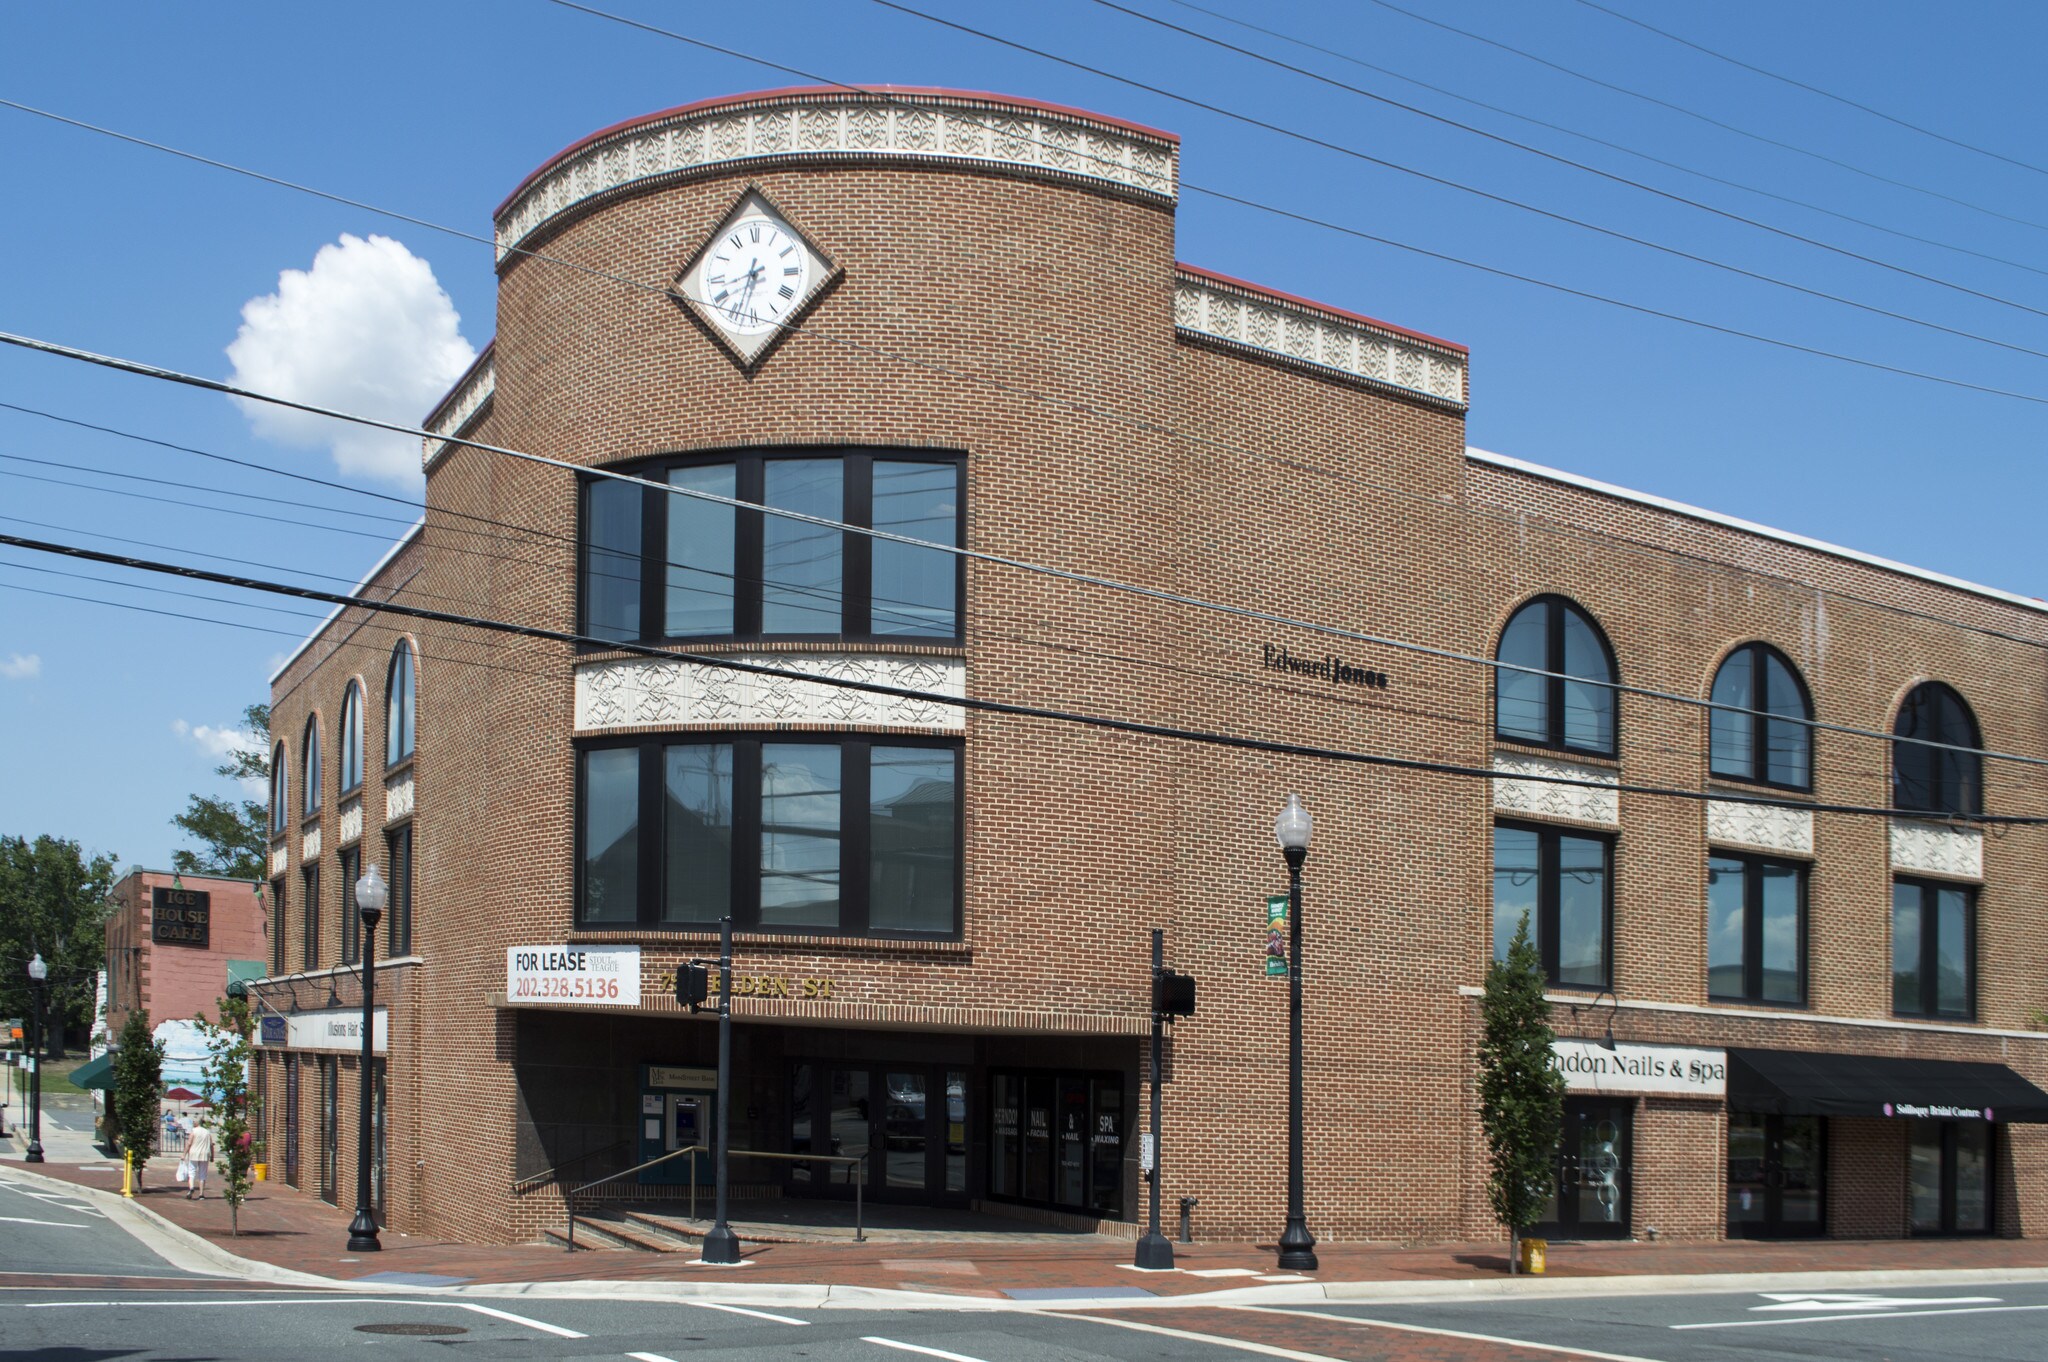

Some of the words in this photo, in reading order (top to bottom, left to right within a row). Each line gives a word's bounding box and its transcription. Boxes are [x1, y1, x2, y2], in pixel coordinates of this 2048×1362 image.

[168, 891, 196, 905] ICE
[154, 908, 208, 923] HOUSE
[516, 953, 538, 971] FOR
[542, 952, 586, 971] LEASE
[516, 977, 619, 998] 202.328.5136
[804, 978, 835, 997] ST
[347, 1021, 358, 1036] Hair
[1612, 1056, 1664, 1077] Nails
[1670, 1059, 1683, 1078] &
[1689, 1060, 1725, 1084] Spa
[1929, 1104, 1952, 1117] Bridal
[1952, 1106, 1982, 1118] Couture
[1031, 1110, 1047, 1127] NAIL
[1068, 1113, 1075, 1130] &
[1099, 1115, 1115, 1133] SPA
[999, 1127, 1018, 1136] MASSAG
[1029, 1129, 1049, 1138] FACIAL
[1065, 1132, 1079, 1141] NAIL
[1094, 1134, 1119, 1145] WAXING
